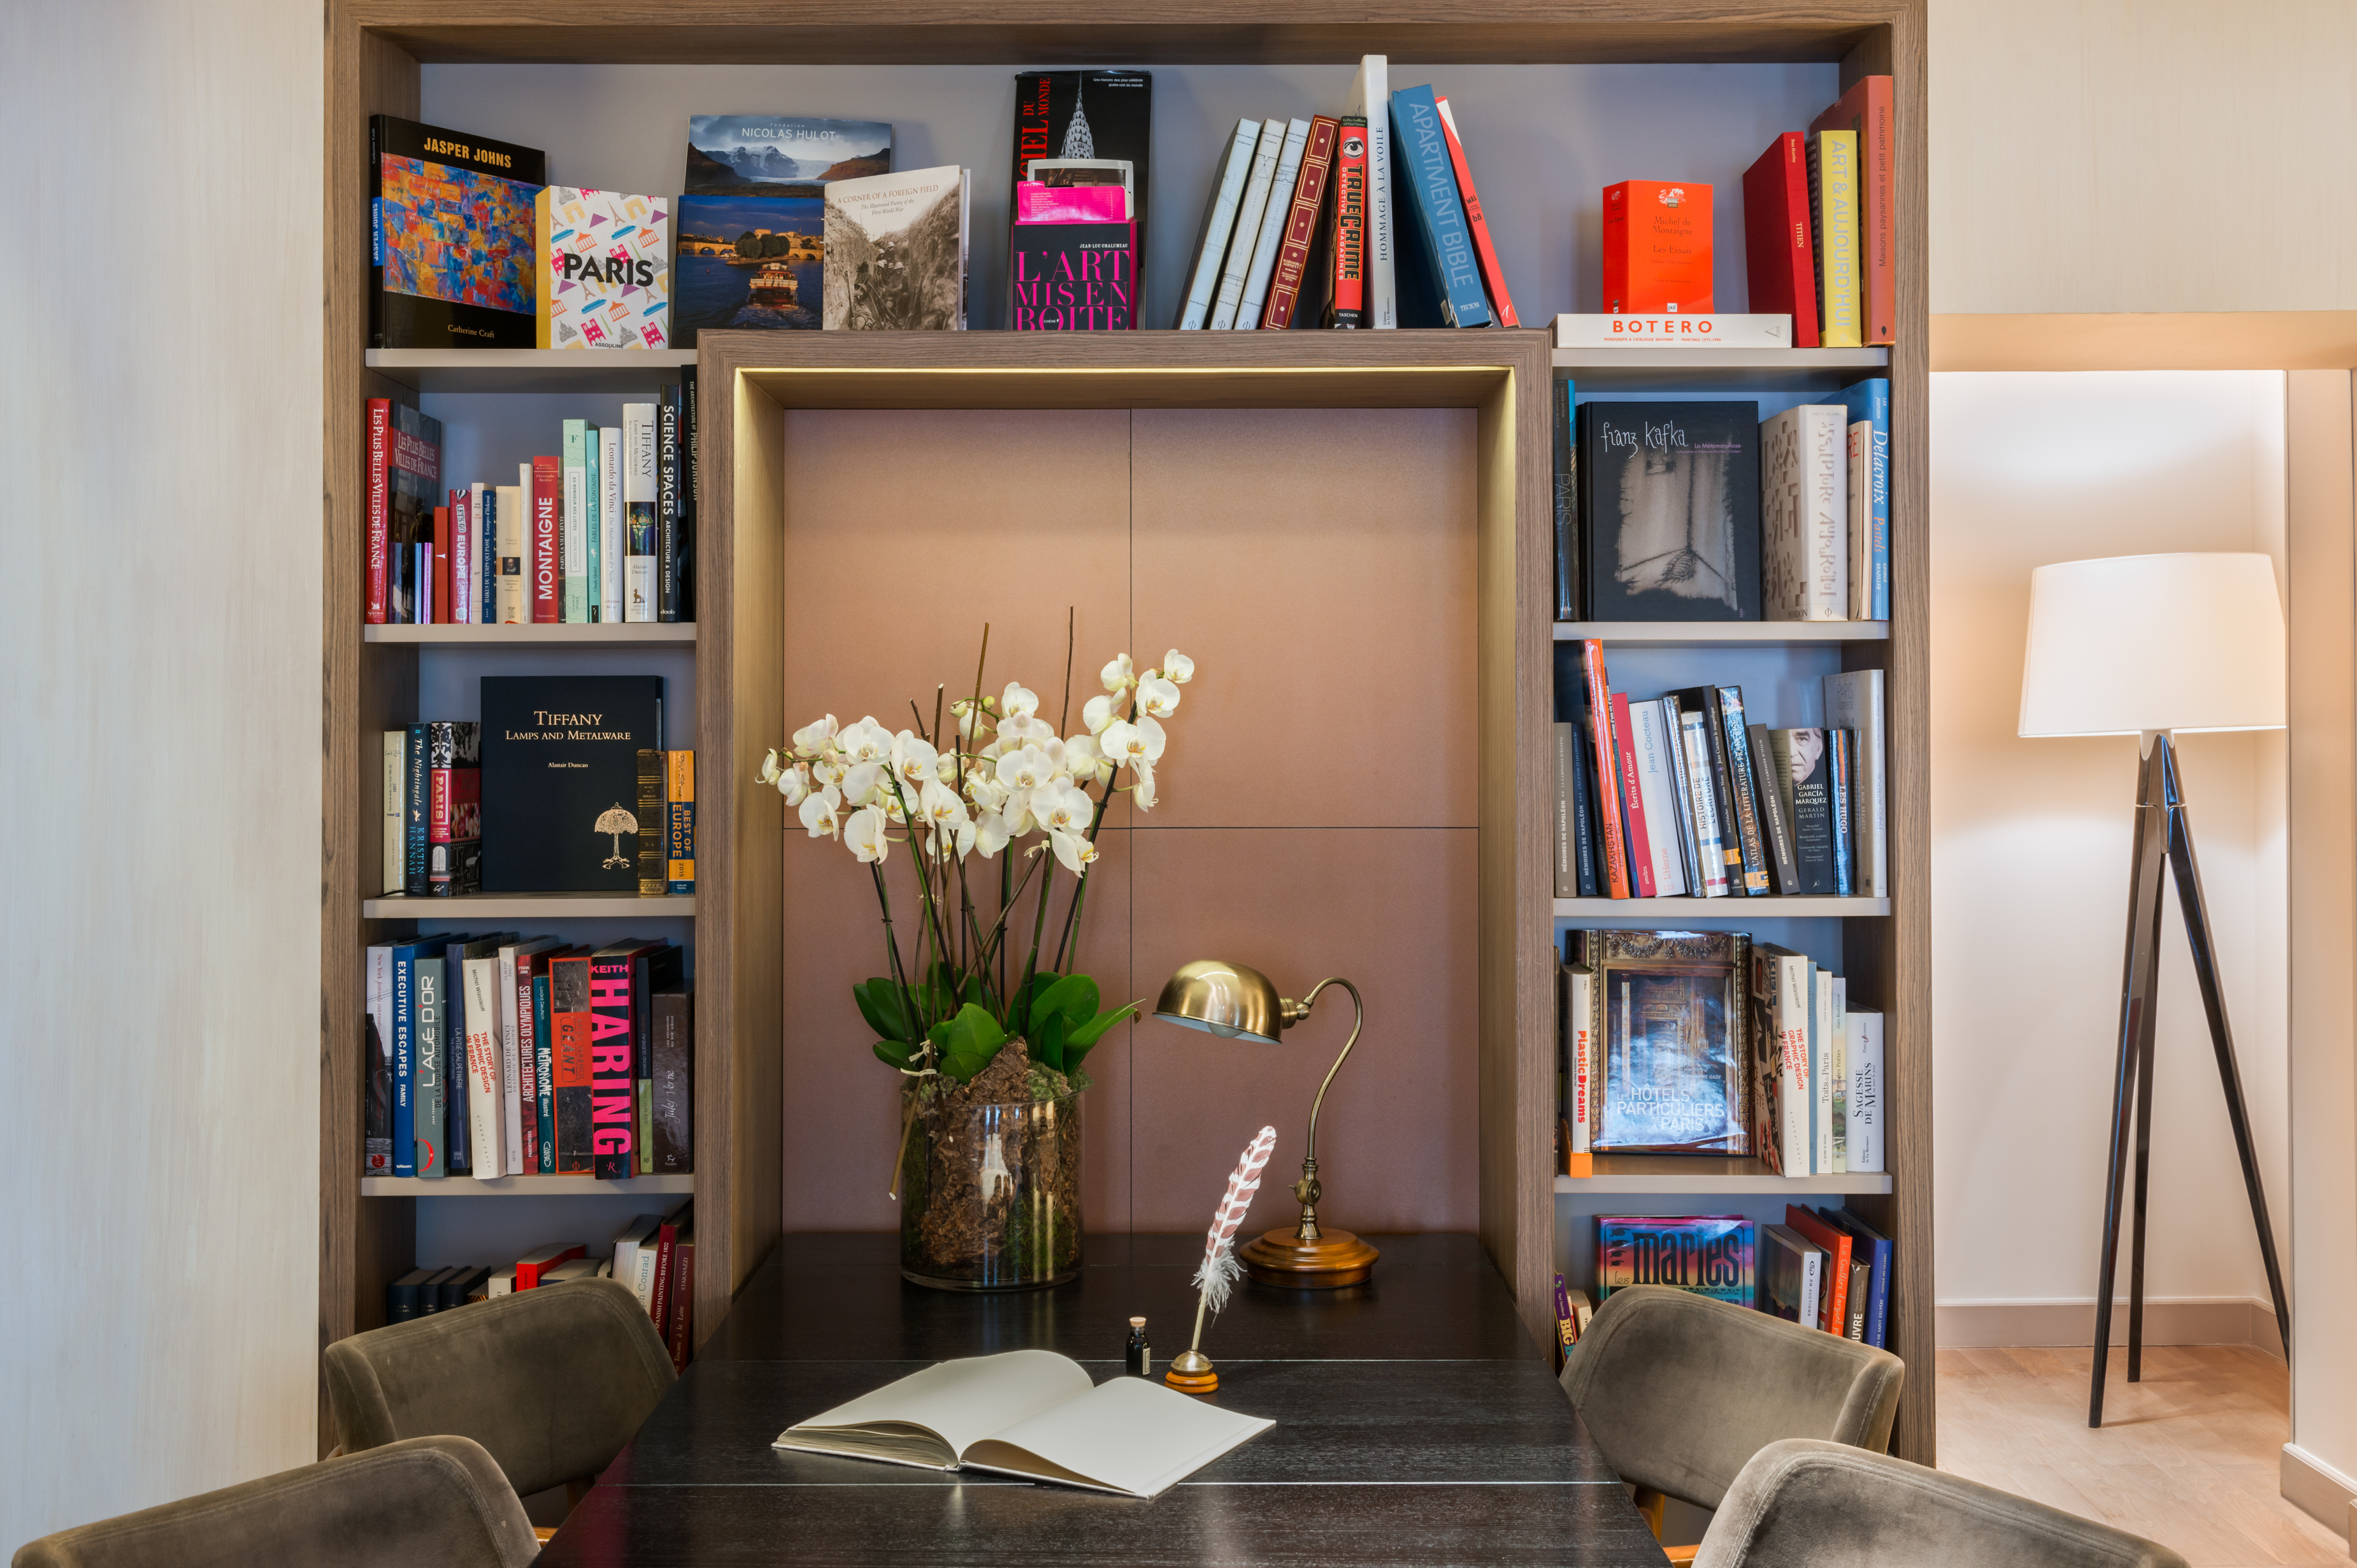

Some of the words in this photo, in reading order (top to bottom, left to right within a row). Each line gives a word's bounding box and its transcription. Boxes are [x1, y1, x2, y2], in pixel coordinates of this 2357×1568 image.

[741, 127, 792, 139] NICOLAS
[796, 130, 836, 141] HULOT
[1878, 106, 1886, 149] patrimoine
[424, 138, 469, 159] JASPER
[474, 148, 512, 168] JOHNS
[1376, 127, 1384, 163] VOILE
[1831, 140, 1847, 178] ART
[1377, 167, 1385, 181] LA
[1832, 182, 1848, 195] &
[843, 194, 871, 203] CORNER
[889, 188, 918, 199] FOREIGN
[920, 185, 938, 194] FIELD
[1409, 103, 1459, 227] APARTMENT
[1442, 231, 1473, 288] BIBLE
[1466, 195, 1477, 205] MAI
[1379, 197, 1387, 261] HOMMAGE
[1652, 225, 1693, 237] Montaigne
[1654, 216, 1680, 225] Michel
[1682, 217, 1691, 226] de
[1653, 245, 1666, 253] Les
[1669, 245, 1692, 255] Essais
[1833, 197, 1851, 326] AUJOURD'HUI
[564, 253, 654, 287] PARIS
[1015, 250, 1129, 282] L'ART
[1014, 282, 1075, 306] MIS
[1085, 282, 1129, 306] EN
[448, 324, 477, 336] Catherine
[479, 328, 494, 339] Craft
[1613, 320, 1712, 333] BOTERO
[664, 406, 674, 461] SCIENCE
[1601, 422, 1638, 459] franz
[642, 421, 654, 478] TIFFANY
[1873, 429, 1888, 504] Delacroix
[609, 481, 616, 490] da
[663, 466, 674, 515] SPACES
[1554, 474, 1572, 525] PARIS
[539, 497, 553, 599] MONTAIGNE
[1873, 517, 1886, 553] Pastels
[457, 536, 466, 579] EUROPE
[1788, 609, 1808, 619] PHAIDON
[534, 711, 603, 725] TIFFANY
[1642, 711, 1652, 750] Cocteau
[505, 731, 539, 740] LAMPS
[568, 731, 631, 740] METALWARE
[1626, 752, 1635, 784] d'Amour
[1649, 753, 1658, 774] Jean
[412, 758, 422, 806] Nightingale
[673, 804, 682, 857] EUROPE
[684, 838, 691, 852] OF
[1605, 823, 1618, 883] KAZAKHSTAN
[1662, 848, 1671, 880] L'Herne
[591, 964, 628, 973] KEITH
[398, 961, 406, 1022] EXECUTIVE
[519, 986, 532, 1037] OLYMPIQUES
[481, 1031, 489, 1046] THE
[1781, 1031, 1786, 1039] IN
[399, 1027, 407, 1078] ESCAPES
[468, 1044, 478, 1074] FRANCE
[473, 1034, 485, 1066] GRAPHIC
[480, 1066, 491, 1093] DESIGN
[484, 1047, 494, 1070] STORY
[591, 979, 632, 1155] HARING
[1782, 1041, 1793, 1070] FRANCE
[1788, 1030, 1799, 1062] GRAPHIC
[1794, 1063, 1804, 1090] DESIGN
[1799, 1044, 1808, 1067] STORY
[490, 1070, 496, 1081] OF
[521, 1038, 534, 1102] ARCHITECTURES
[663, 1070, 674, 1095] Verne
[1803, 1069, 1809, 1078] OF
[1865, 1062, 1875, 1108] MARINS
[1631, 1084, 1690, 1102] HÔTELS
[1853, 1069, 1863, 1118] SAGESSE
[663, 1095, 680, 1123] Jules
[1617, 1101, 1724, 1117] PARTICULIERS
[1865, 1110, 1872, 1125] DE
[1661, 1118, 1704, 1131] PARIS
[638, 1256, 649, 1291] Conrad
[1615, 1271, 1630, 1285] les
[1560, 1318, 1570, 1346] BIG
